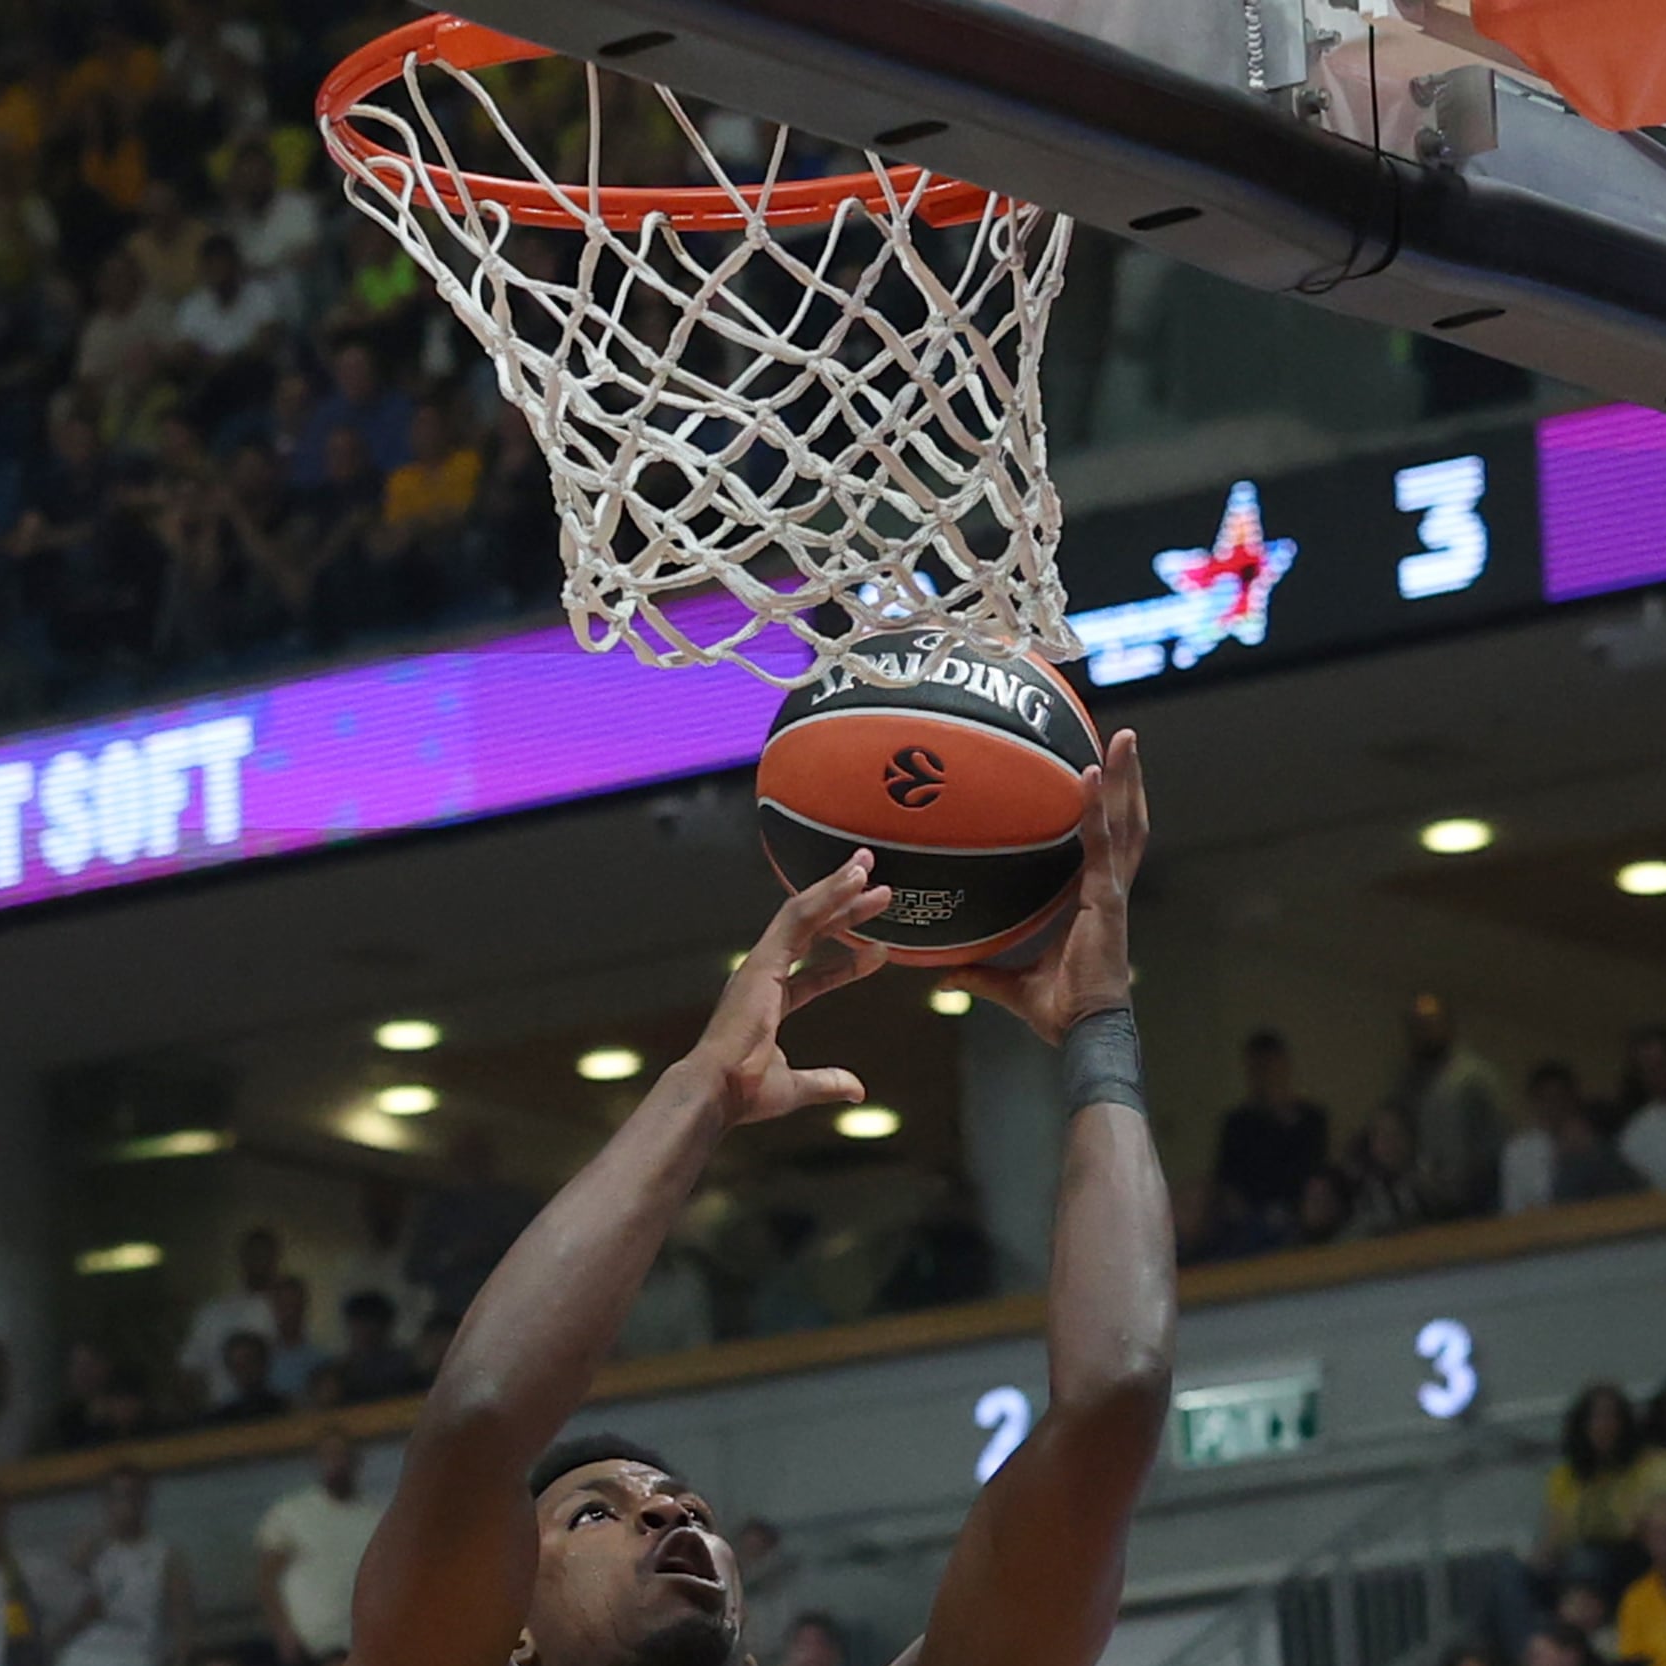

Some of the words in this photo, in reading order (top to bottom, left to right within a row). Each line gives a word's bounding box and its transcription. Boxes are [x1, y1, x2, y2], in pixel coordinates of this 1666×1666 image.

[1395, 458, 1487, 600] 3
[38, 716, 254, 876] SOFT
[1416, 1319, 1477, 1418] 3
